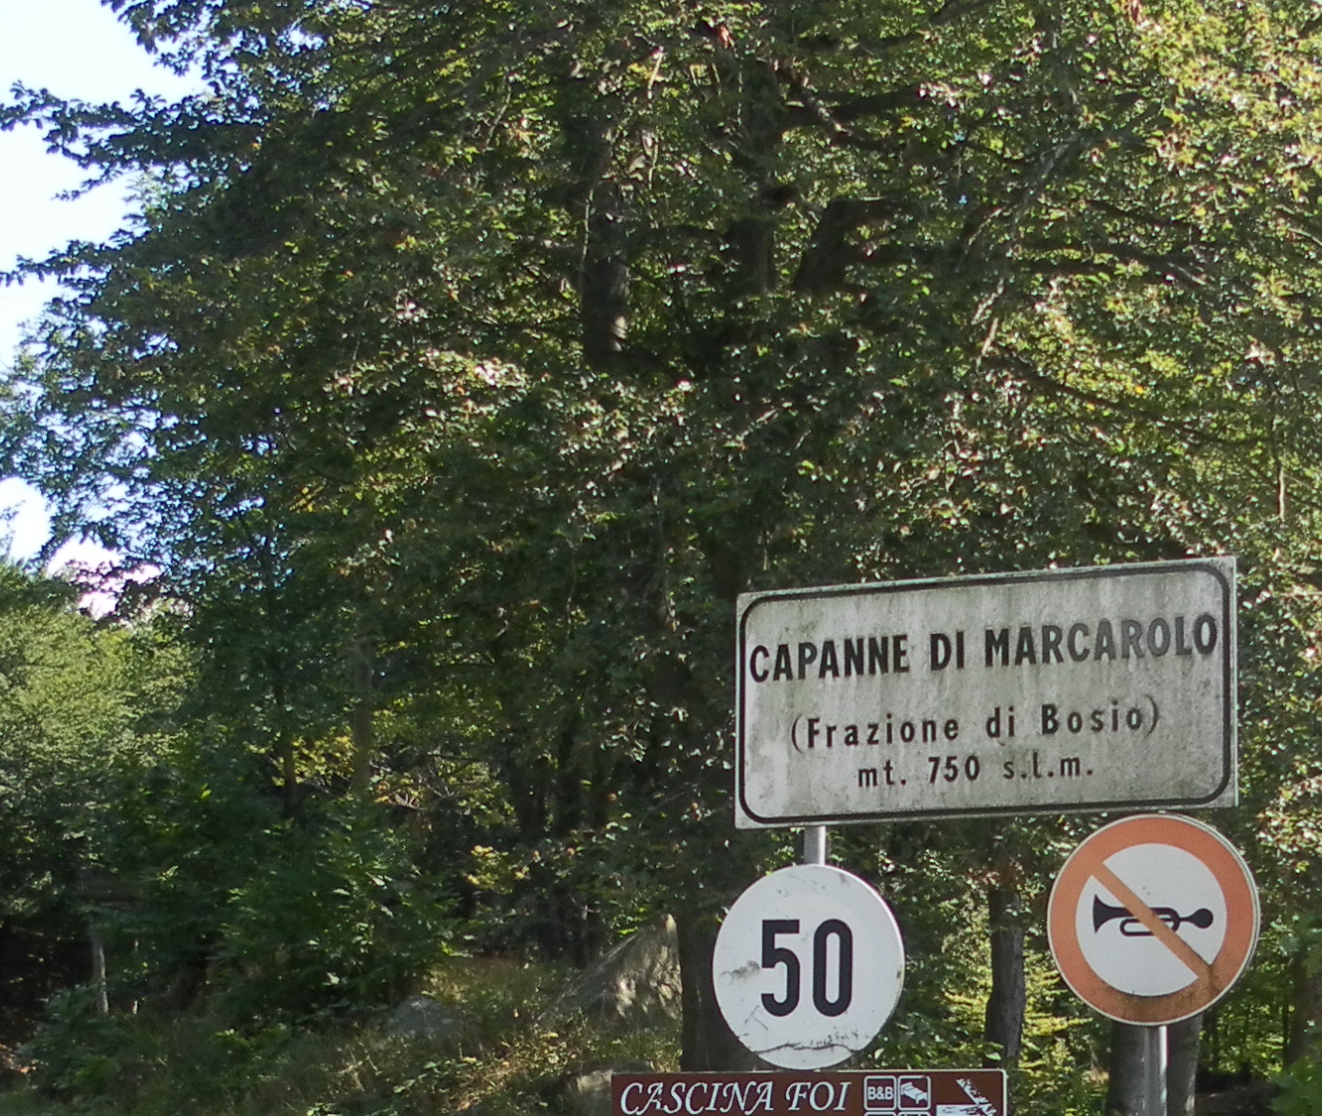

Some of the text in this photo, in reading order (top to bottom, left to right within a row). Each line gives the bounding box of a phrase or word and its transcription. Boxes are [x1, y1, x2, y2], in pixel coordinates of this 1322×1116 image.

[749, 612, 1218, 683] CAPANNE DI MARCAROLO
[791, 695, 1160, 754] (Frazione di Bosio)
[858, 751, 1095, 789] mt. 750 s.l.m.
[761, 919, 853, 1017] 50
[620, 1081, 851, 1115] CASCINA FOI
[868, 1087, 894, 1100] B&B
